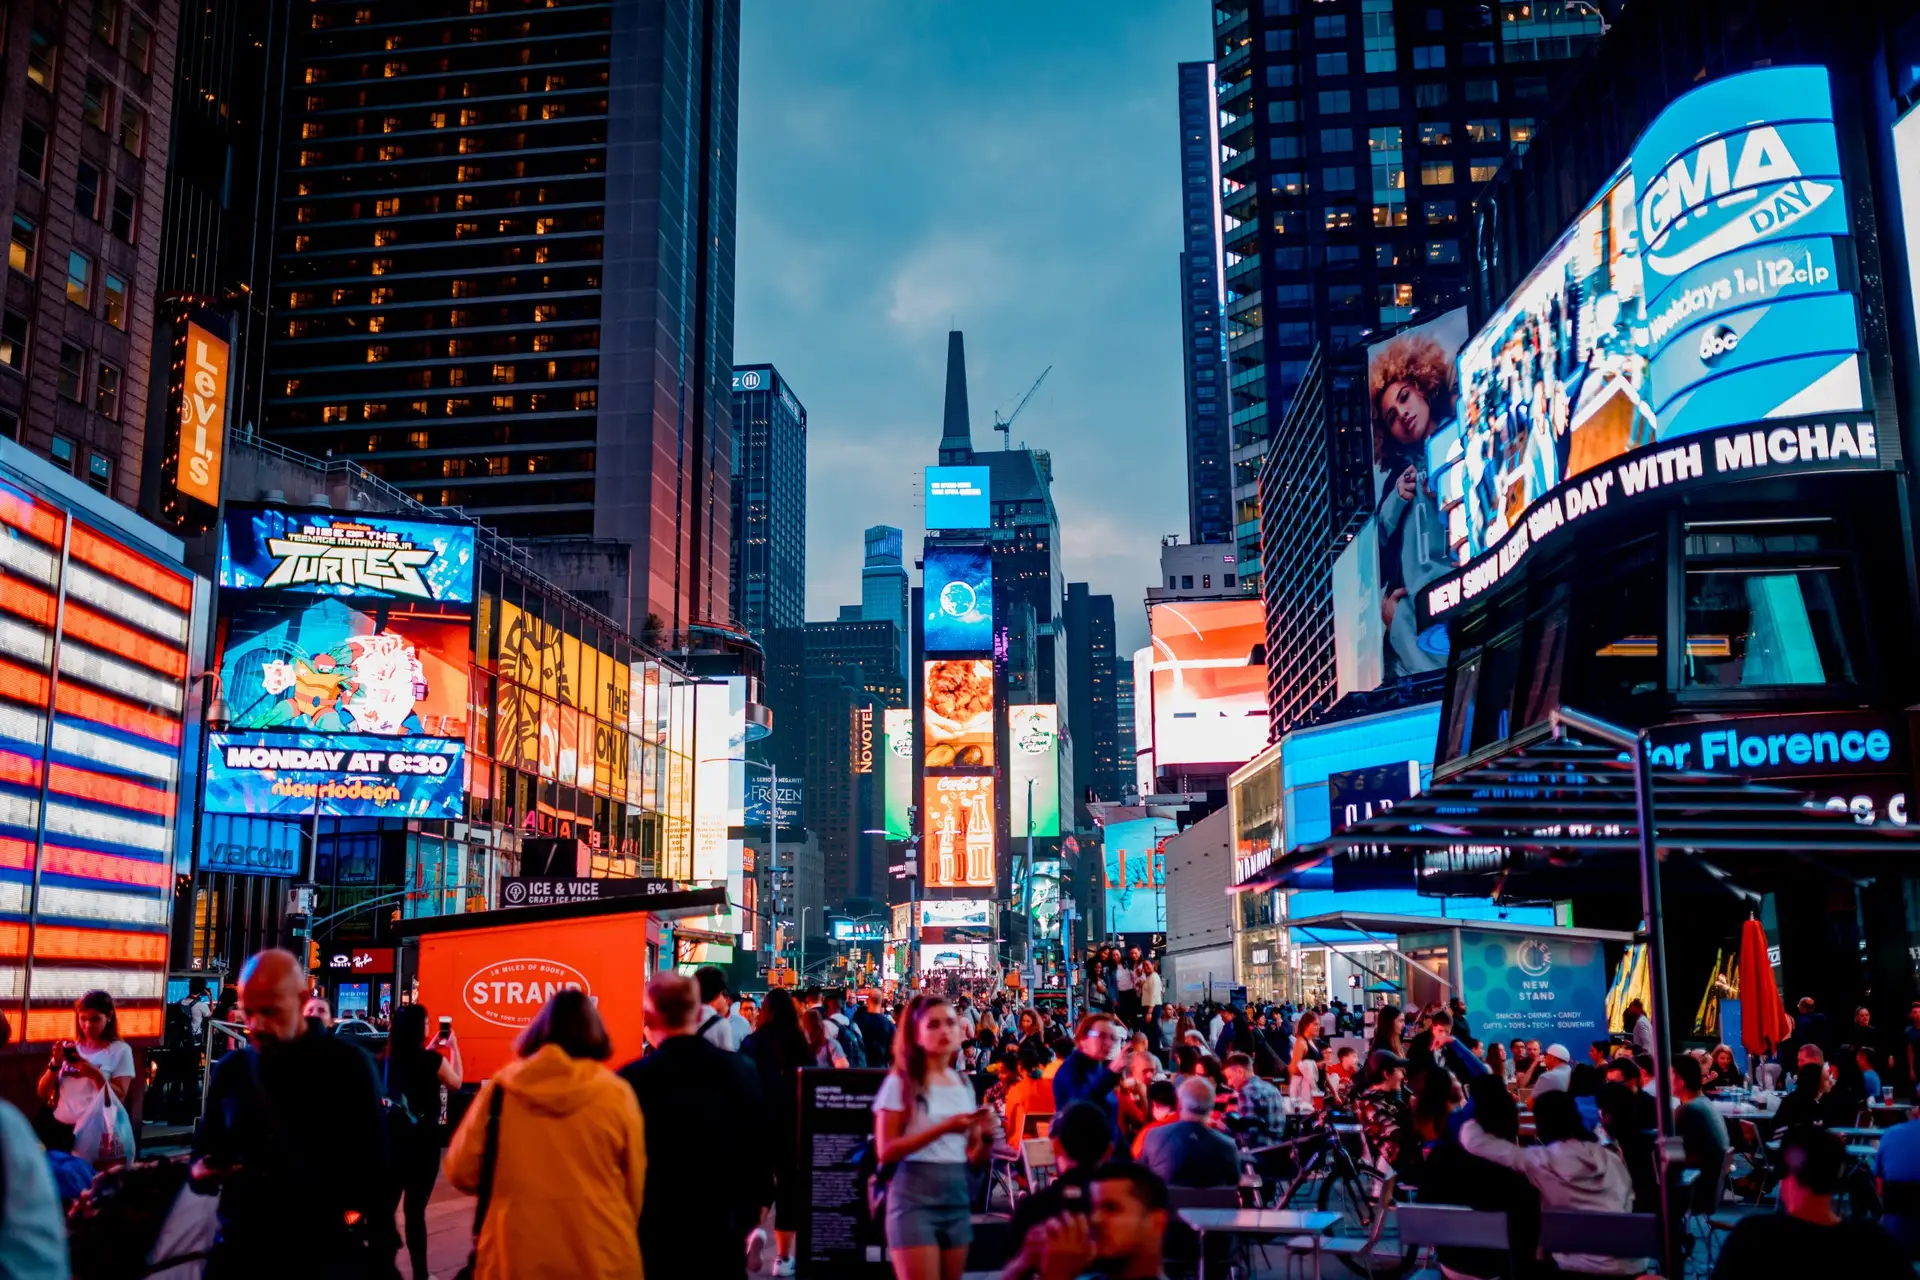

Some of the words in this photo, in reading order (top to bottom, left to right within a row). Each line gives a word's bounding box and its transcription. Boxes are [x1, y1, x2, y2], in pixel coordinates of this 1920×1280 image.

[1641, 120, 1803, 250] GMA
[1749, 181, 1811, 233] DAY
[1699, 331, 1739, 359] abc
[1618, 442, 1703, 498] WITH
[288, 532, 336, 545] TEENAGE
[337, 537, 381, 548] MUTANT
[381, 541, 412, 550] NINJA
[303, 525, 344, 537] RISE
[366, 530, 398, 541] THE
[263, 539, 436, 600] TURTLES
[861, 703, 873, 773] NOVOTEL
[1700, 728, 1890, 770] Florence
[227, 747, 345, 771] MONDAY
[347, 753, 384, 772] AT
[387, 753, 448, 775] 6:30
[751, 785, 802, 803] FROZEN
[528, 896, 553, 904] CRAFT
[529, 882, 551, 895] ICE
[555, 883, 565, 894] &
[568, 882, 599, 895] VICE
[502, 964, 525, 973] MILES
[540, 965, 565, 976] BOOKS
[1519, 992, 1555, 1000] STAND
[1557, 1021, 1595, 1029] SOUVENIRS
